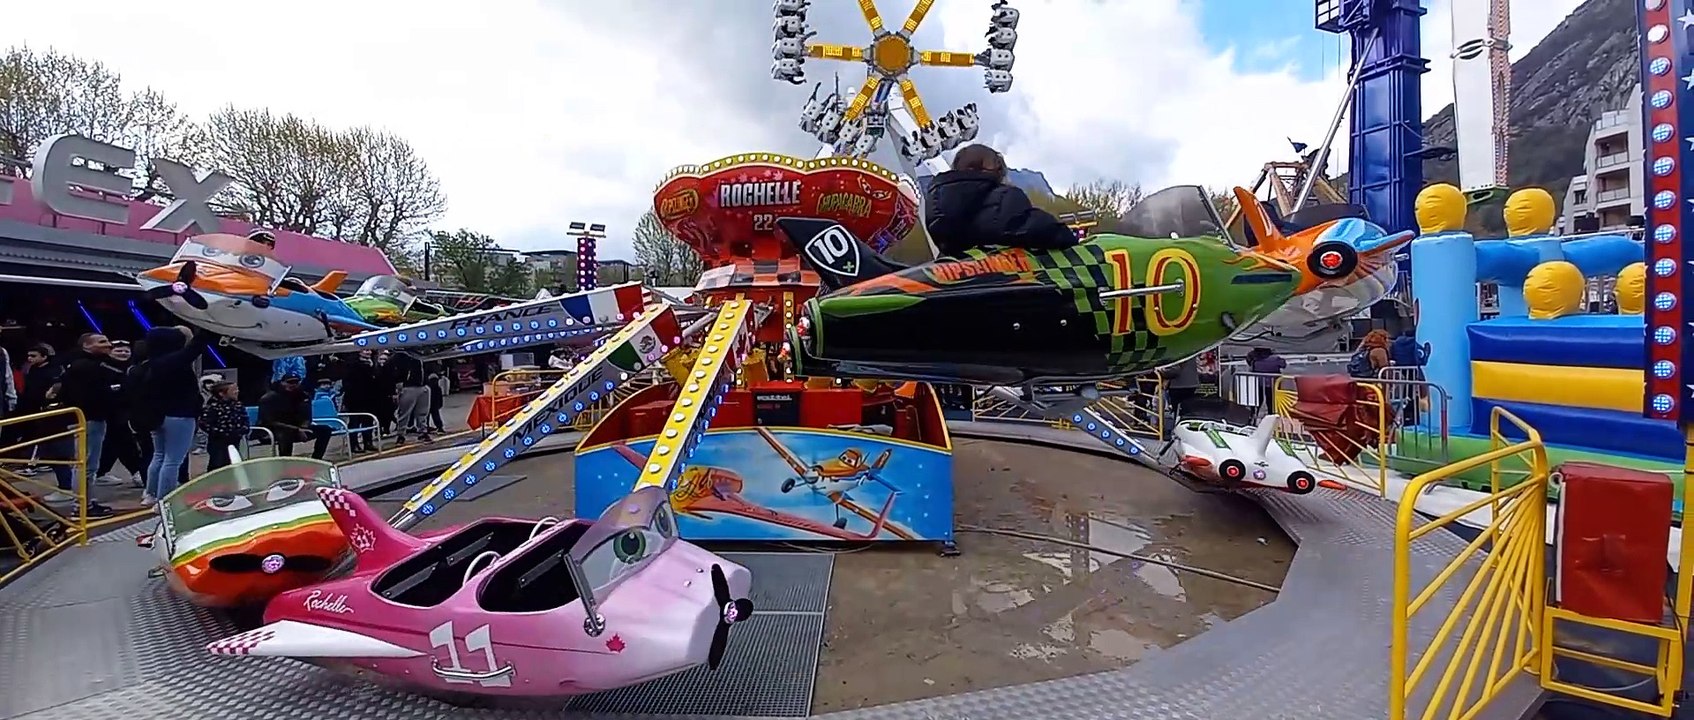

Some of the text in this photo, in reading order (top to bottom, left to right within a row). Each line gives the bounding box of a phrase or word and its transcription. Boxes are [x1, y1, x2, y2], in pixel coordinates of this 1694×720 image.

[720, 180, 802, 207] ROCHELLE
[813, 228, 849, 265] 10
[1104, 247, 1201, 337] 10
[449, 305, 552, 330] FRANCE
[512, 366, 603, 445] MEXIQUE
[303, 589, 355, 613] Rochelle
[429, 620, 512, 688] 11
